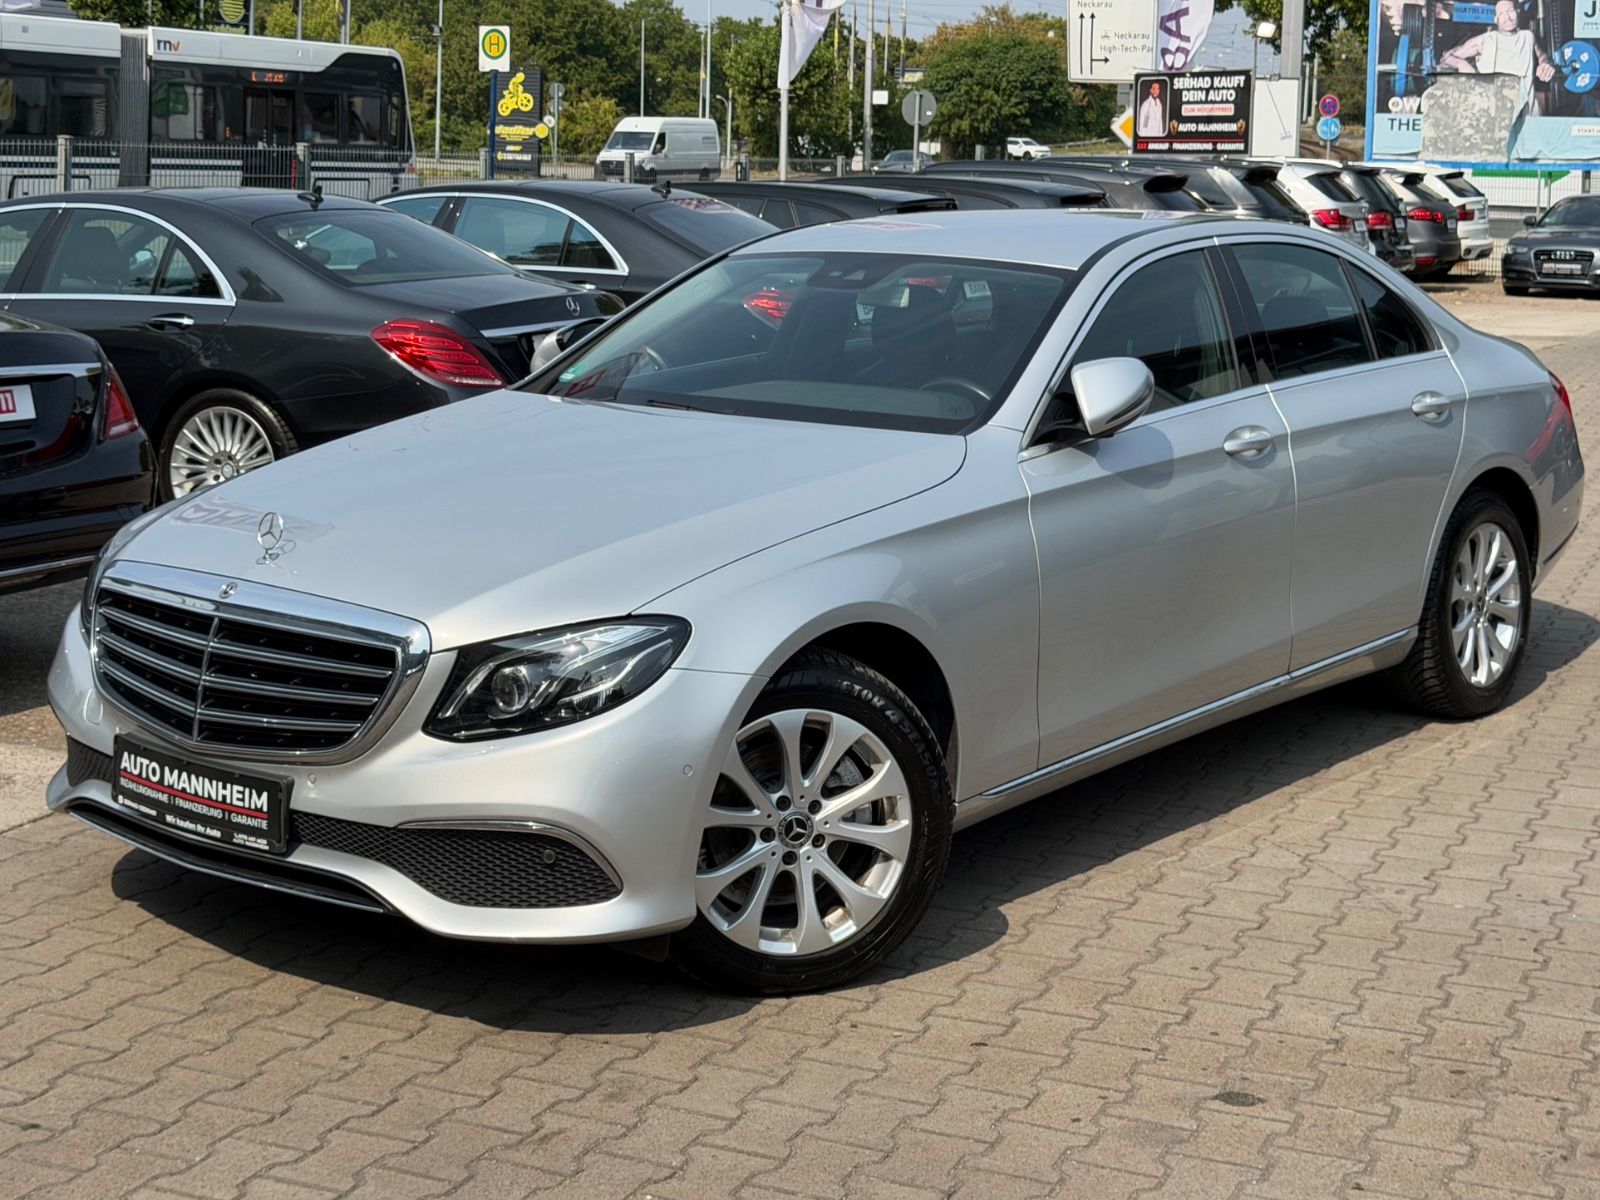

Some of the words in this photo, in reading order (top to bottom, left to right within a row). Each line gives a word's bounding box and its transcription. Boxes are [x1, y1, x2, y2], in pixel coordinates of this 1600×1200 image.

[1114, 31, 1150, 39] Neckarau
[156, 39, 180, 52] rnv
[489, 35, 500, 54] H
[1173, 76, 1211, 89] SERHAD
[1213, 75, 1246, 88] KAUFT
[1182, 90, 1206, 102] DEIN
[1208, 89, 1236, 101] AUTO
[1388, 96, 1421, 114] OW
[1178, 123, 1197, 132] AUTO
[1197, 122, 1237, 132] MANNHEIM
[1388, 118, 1421, 131] THE
[120, 751, 160, 782] AUTO
[164, 766, 268, 812] MANNHEIM
[176, 797, 222, 819] FINANZIERUNG
[231, 813, 269, 830] GARANTIE
